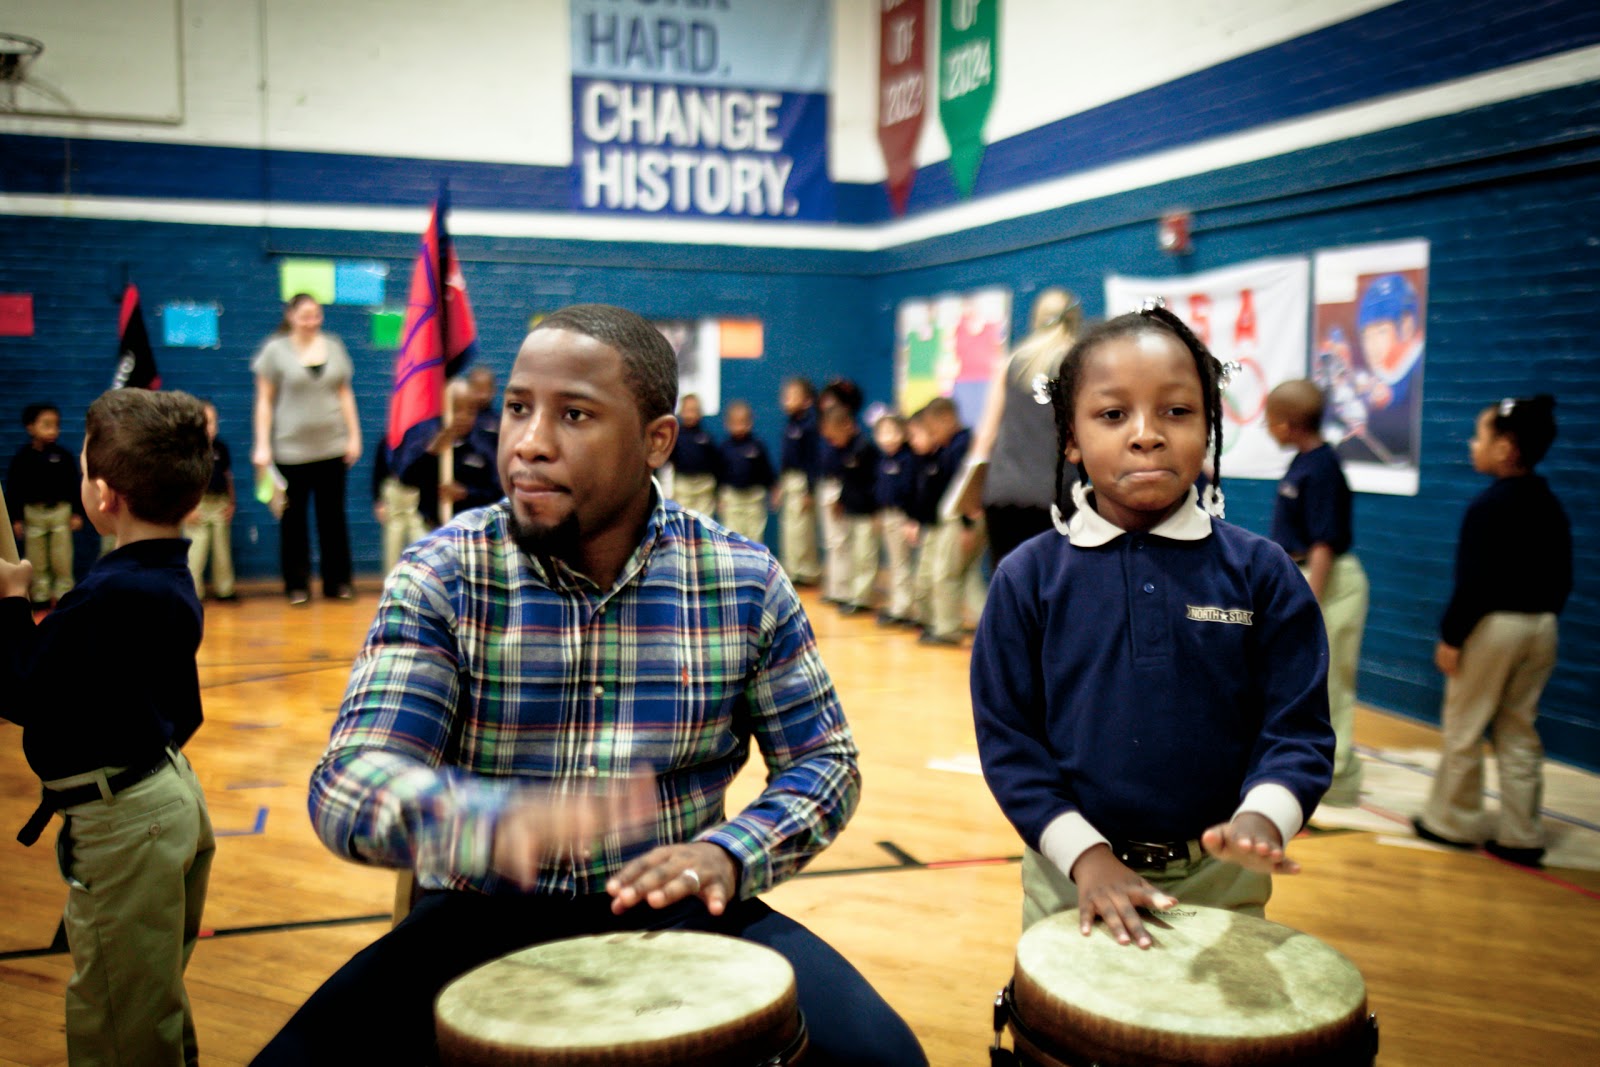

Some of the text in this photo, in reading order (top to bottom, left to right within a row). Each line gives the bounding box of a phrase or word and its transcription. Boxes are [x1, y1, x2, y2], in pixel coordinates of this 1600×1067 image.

[584, 12, 731, 76] HARD.
[887, 16, 916, 65] OF
[941, 38, 991, 100] 2024
[583, 82, 784, 151] CHANGE
[583, 148, 799, 216] HISTORY.
[1191, 608, 1248, 623] NORTH STAR
